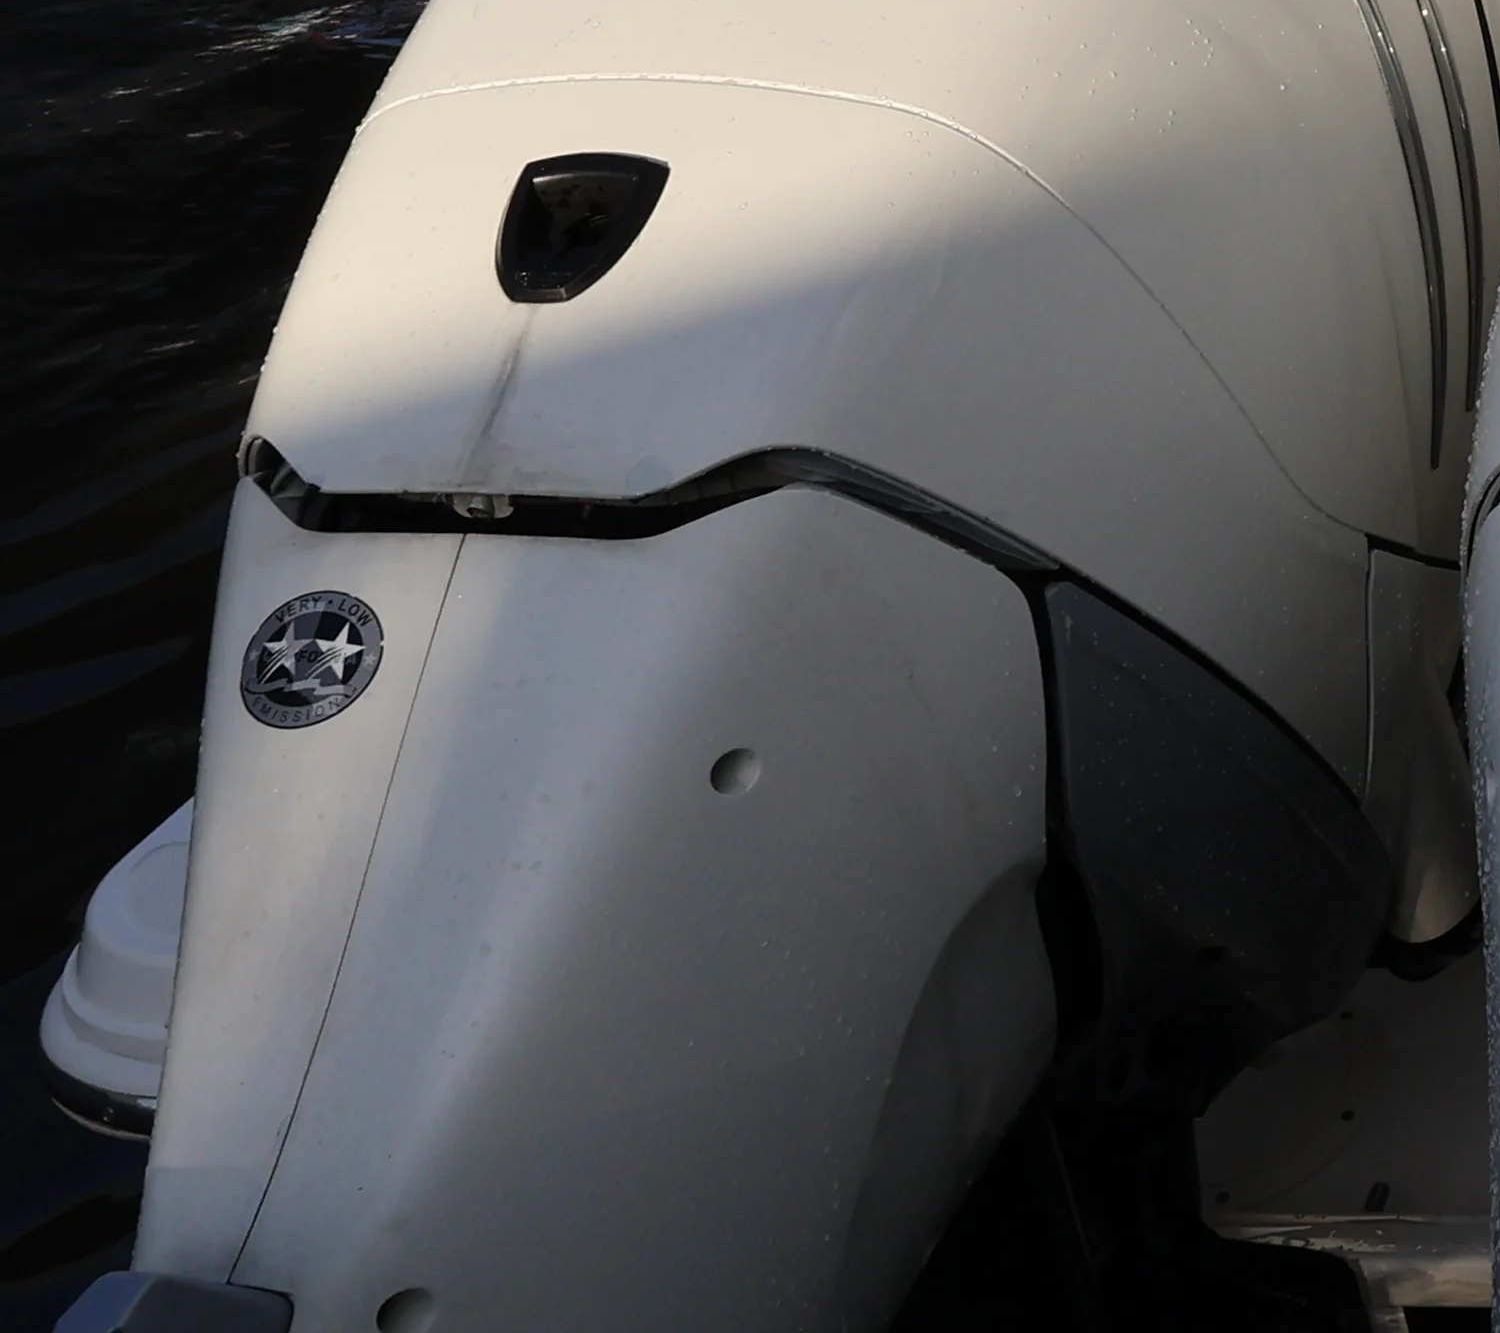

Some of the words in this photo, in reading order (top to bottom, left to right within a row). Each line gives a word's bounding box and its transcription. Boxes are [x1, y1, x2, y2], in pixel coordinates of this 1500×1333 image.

[274, 595, 322, 624] VERY
[337, 596, 373, 628] LOW
[251, 696, 342, 723] EMISSION
